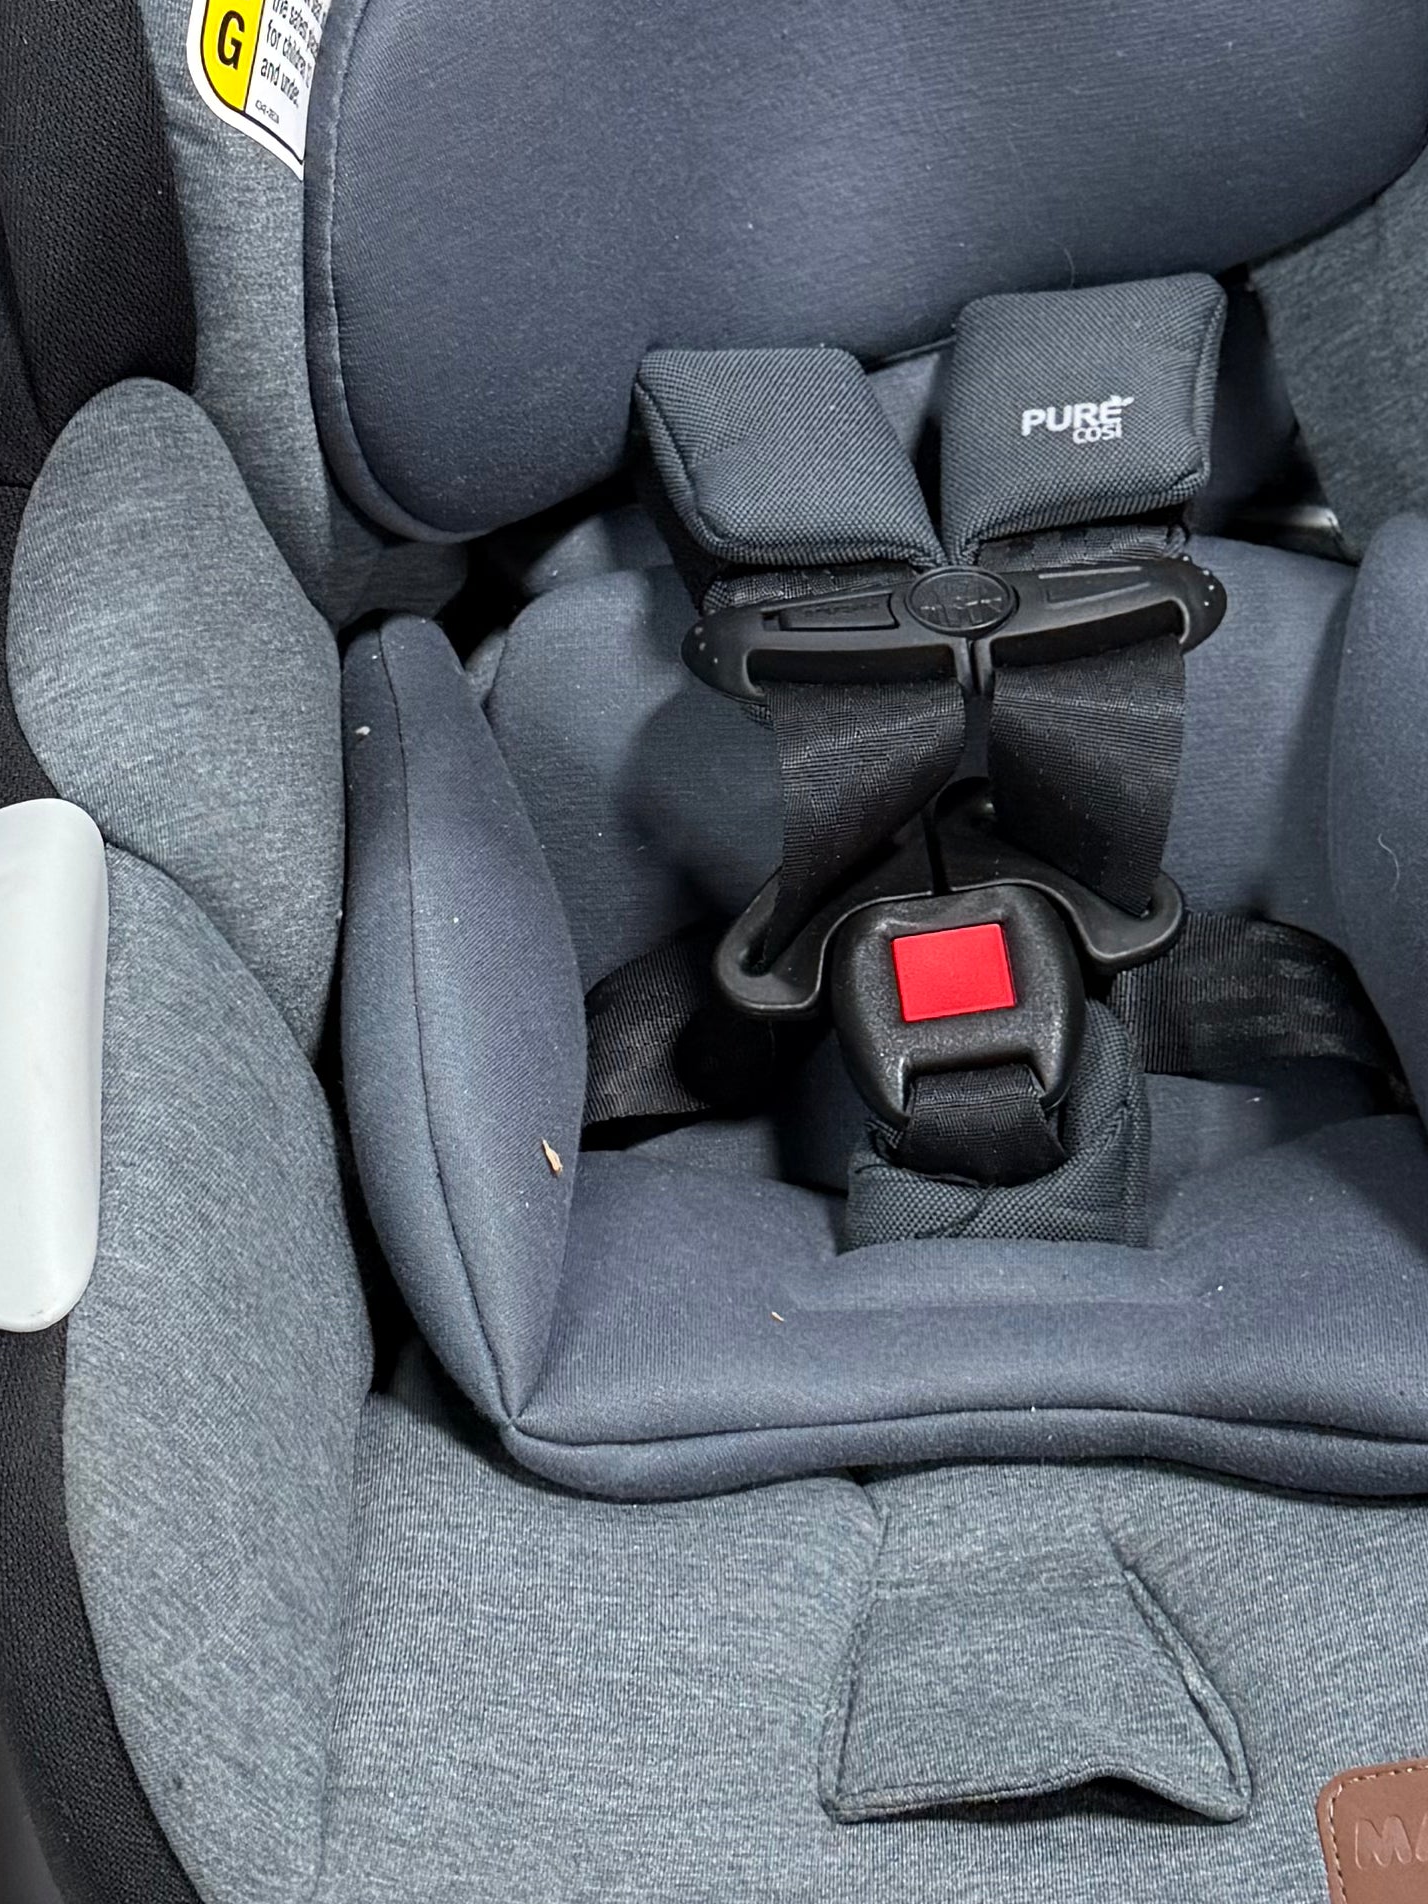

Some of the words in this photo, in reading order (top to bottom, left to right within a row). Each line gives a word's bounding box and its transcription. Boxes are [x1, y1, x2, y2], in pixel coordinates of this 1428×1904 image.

[266, 18, 282, 48] for
[260, 57, 281, 86] and
[1072, 423, 1123, 445] COSI
